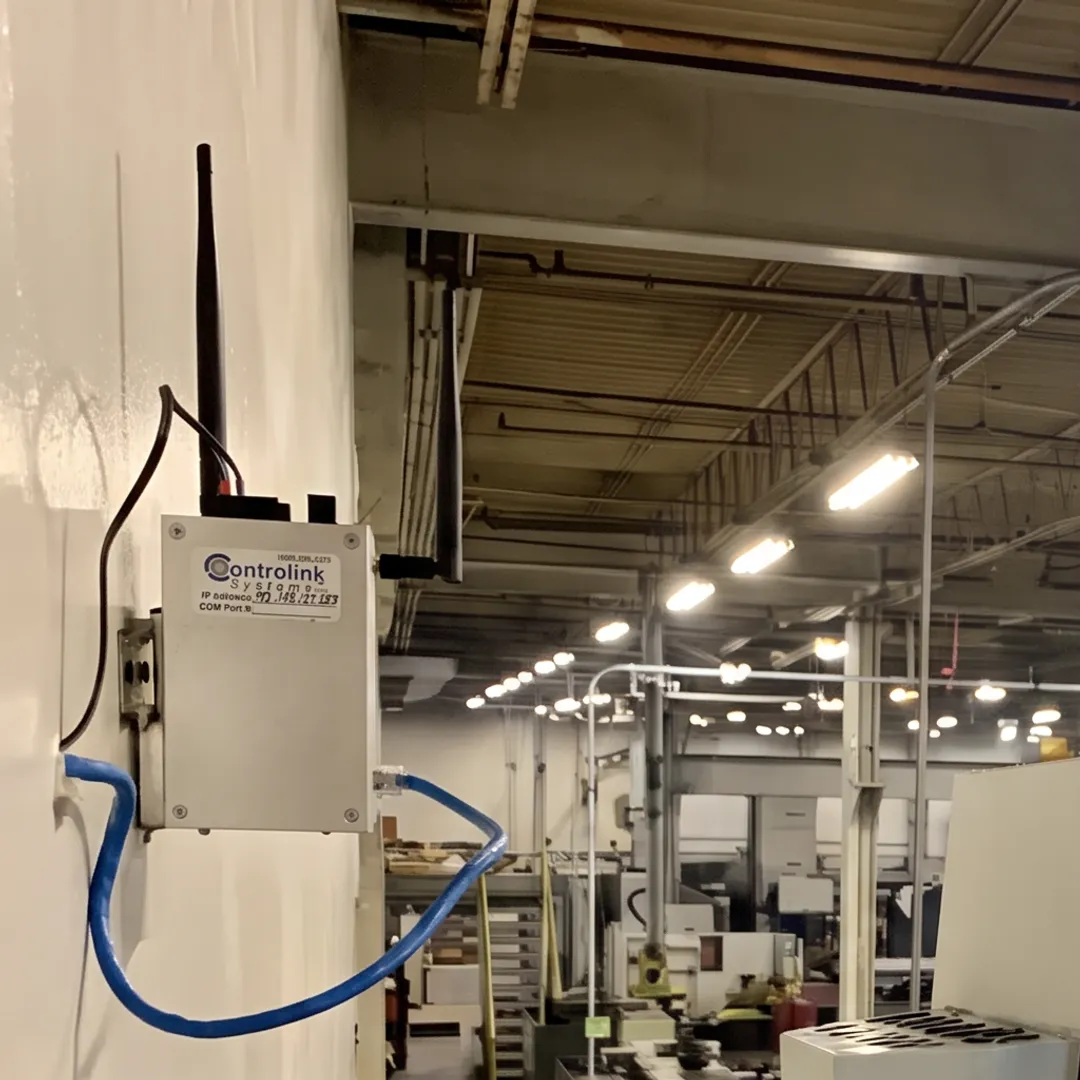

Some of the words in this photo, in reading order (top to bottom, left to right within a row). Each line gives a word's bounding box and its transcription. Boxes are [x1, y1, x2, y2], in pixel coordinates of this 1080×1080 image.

[204, 553, 325, 585] Controlink
[199, 602, 222, 611] COM
[223, 604, 243, 613] Port
